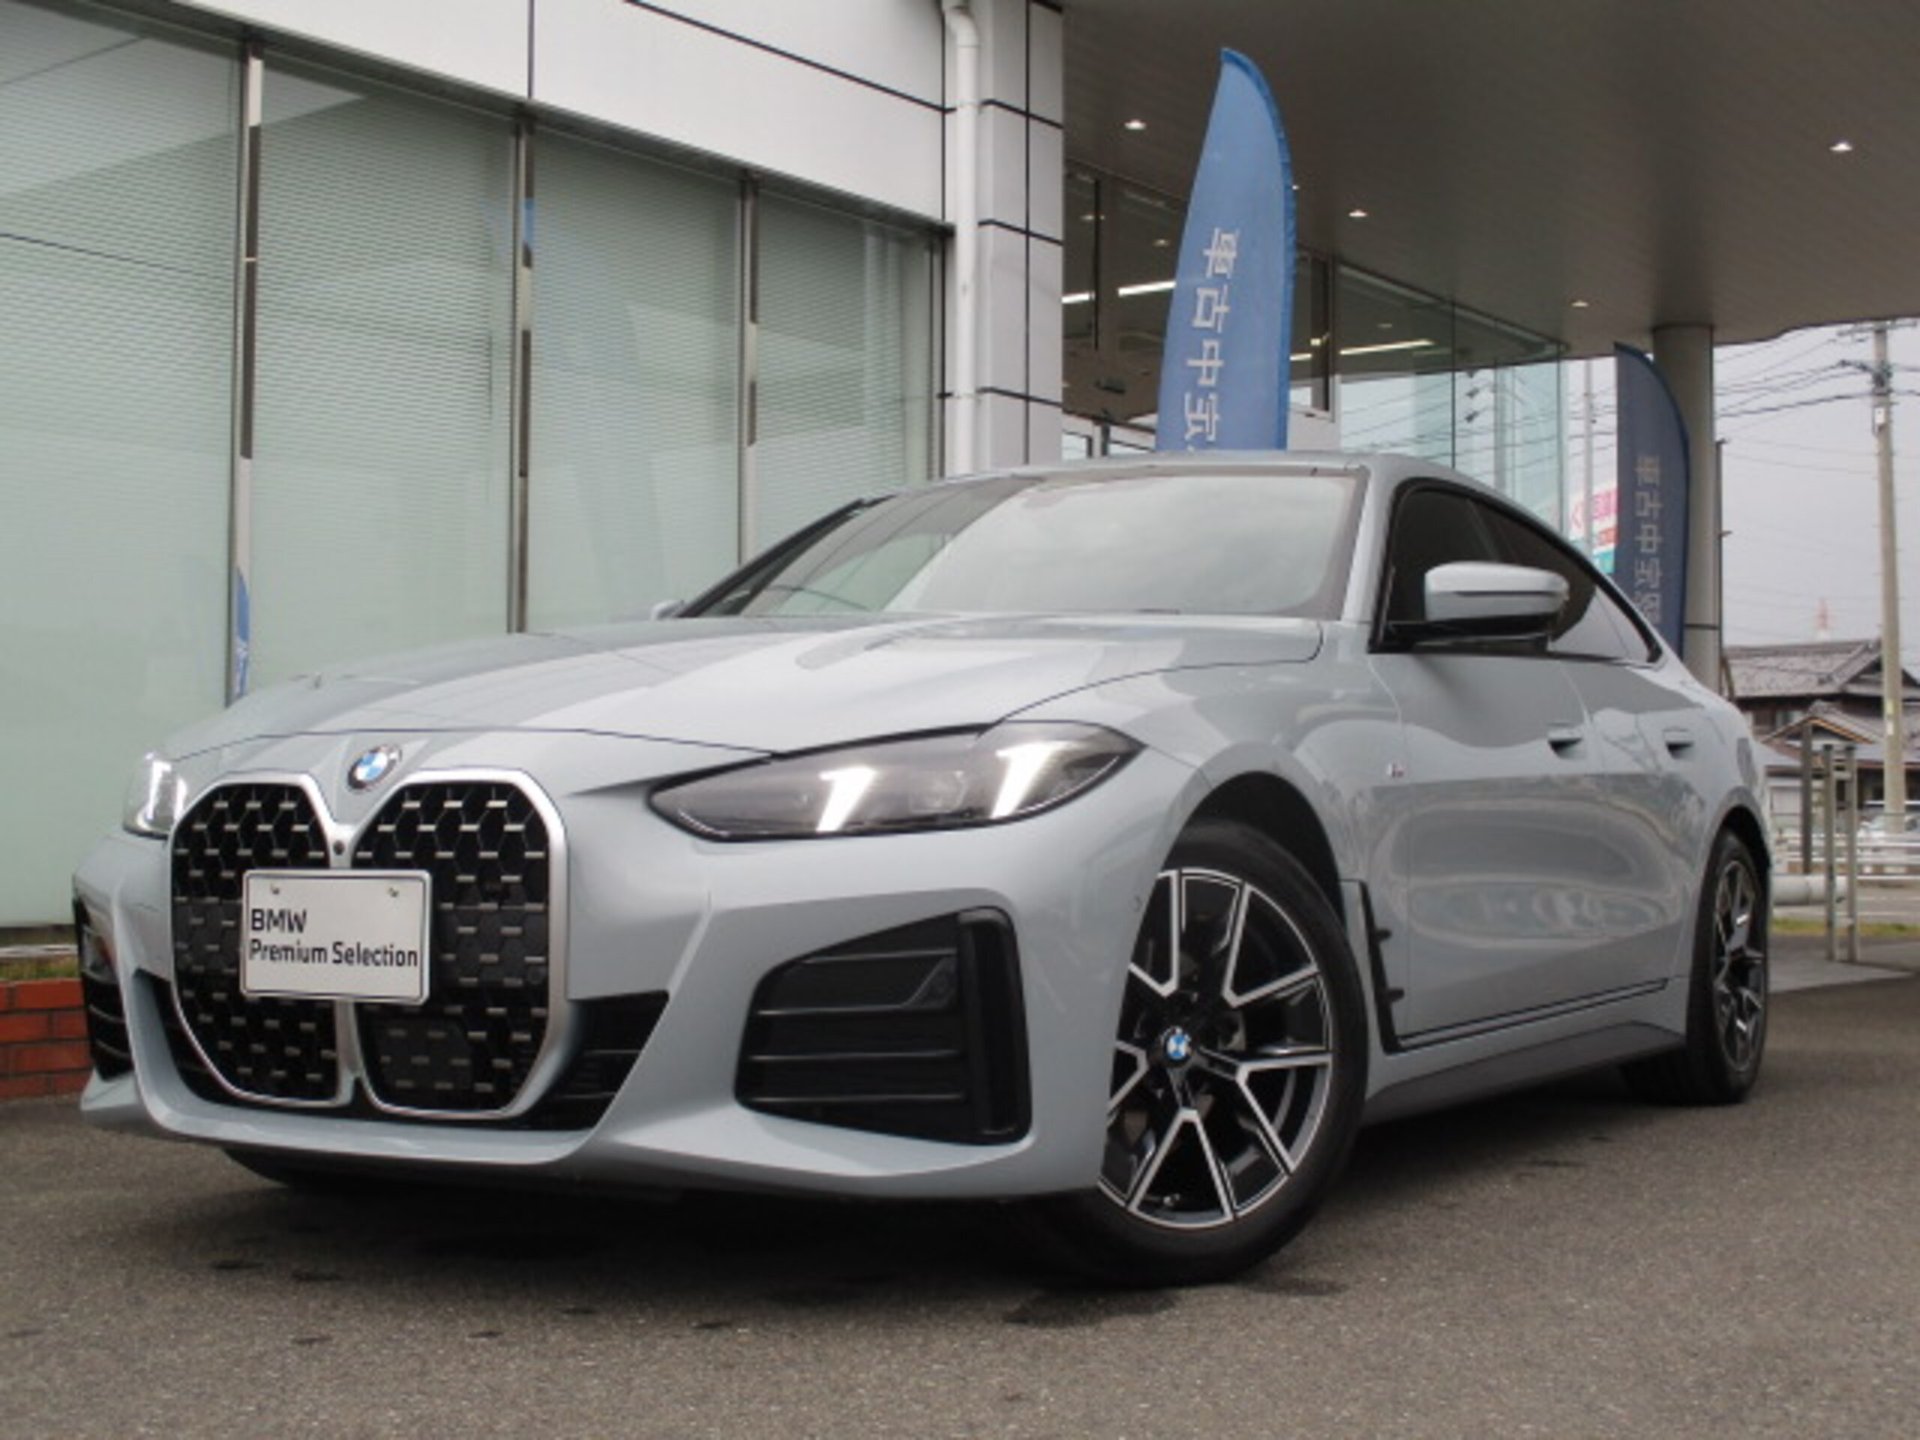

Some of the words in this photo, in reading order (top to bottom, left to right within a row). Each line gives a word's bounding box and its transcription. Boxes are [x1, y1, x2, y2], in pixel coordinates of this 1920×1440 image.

[251, 908, 307, 933] BMW
[250, 938, 327, 963] Premium
[332, 941, 418, 968] Selection
